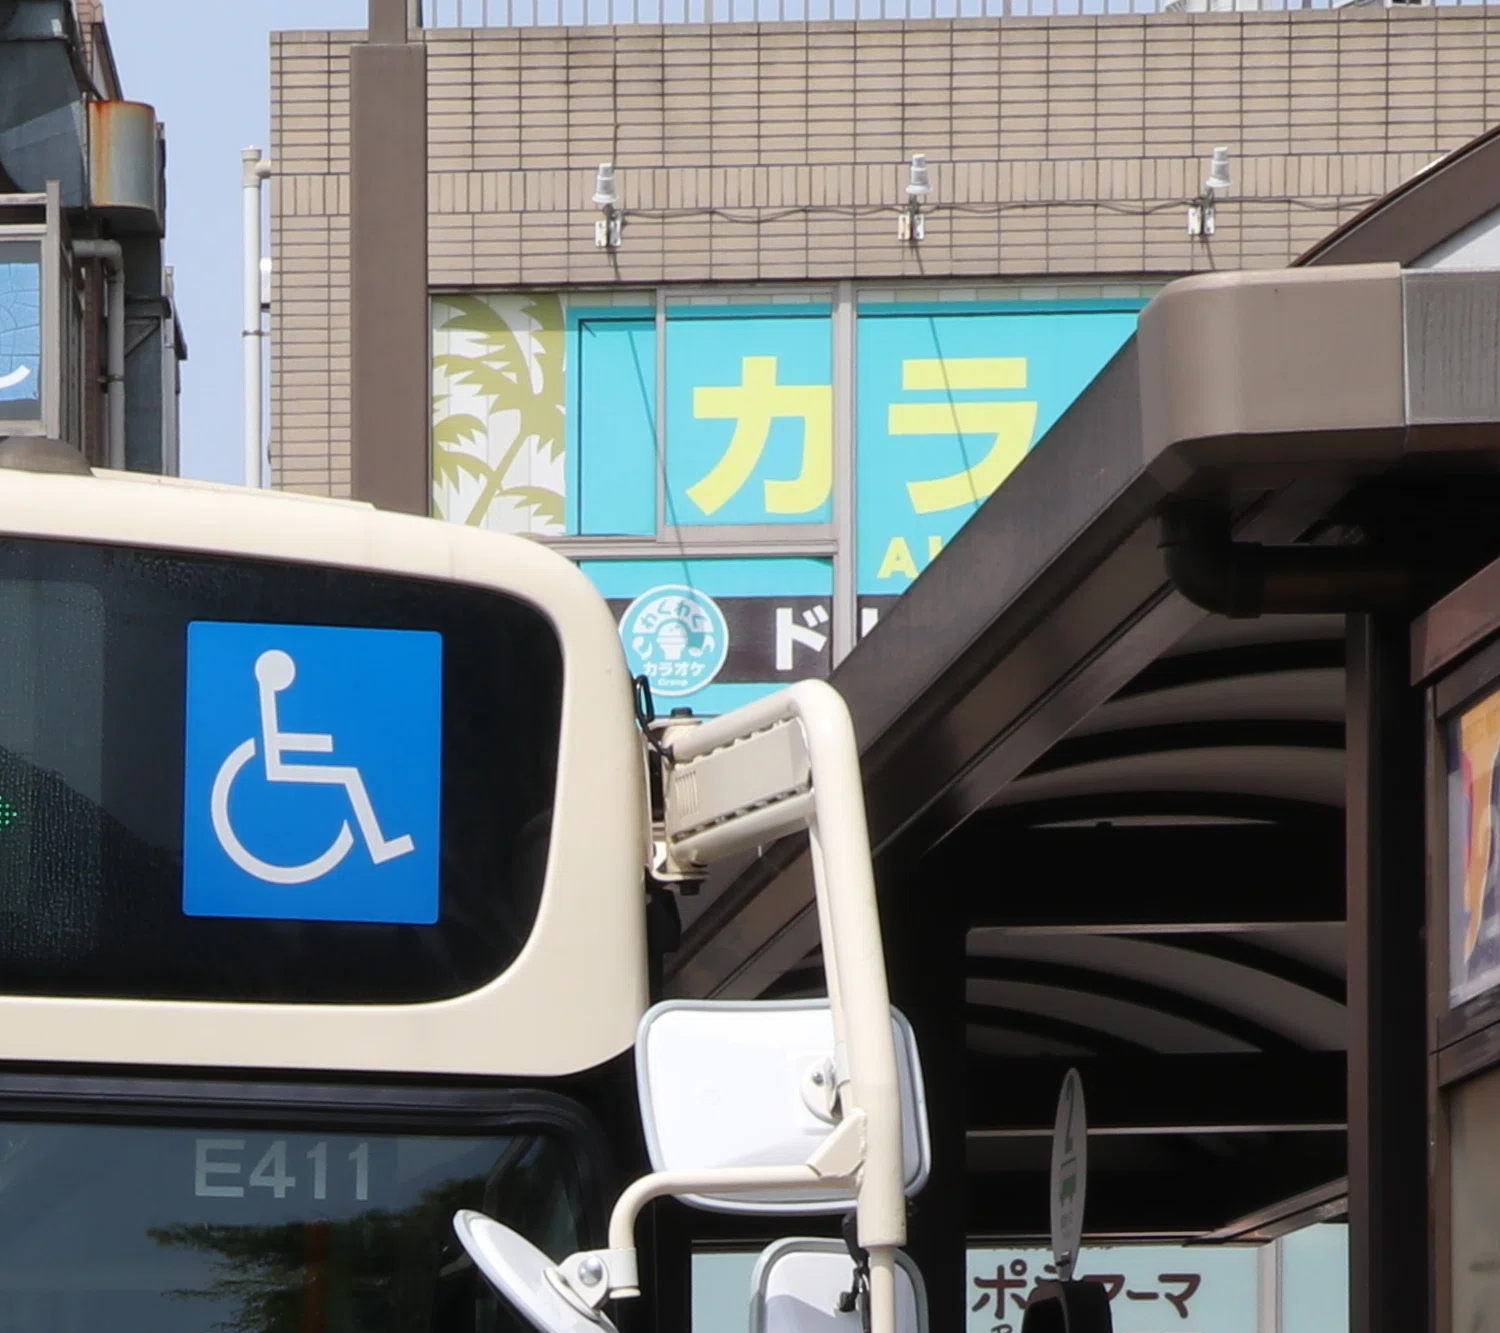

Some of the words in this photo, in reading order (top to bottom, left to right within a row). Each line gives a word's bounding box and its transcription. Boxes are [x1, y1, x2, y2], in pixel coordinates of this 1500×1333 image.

[877, 536, 943, 578] A
[640, 599, 707, 629] わくわく
[642, 660, 706, 677] カラオケ
[195, 1138, 370, 1200] E411
